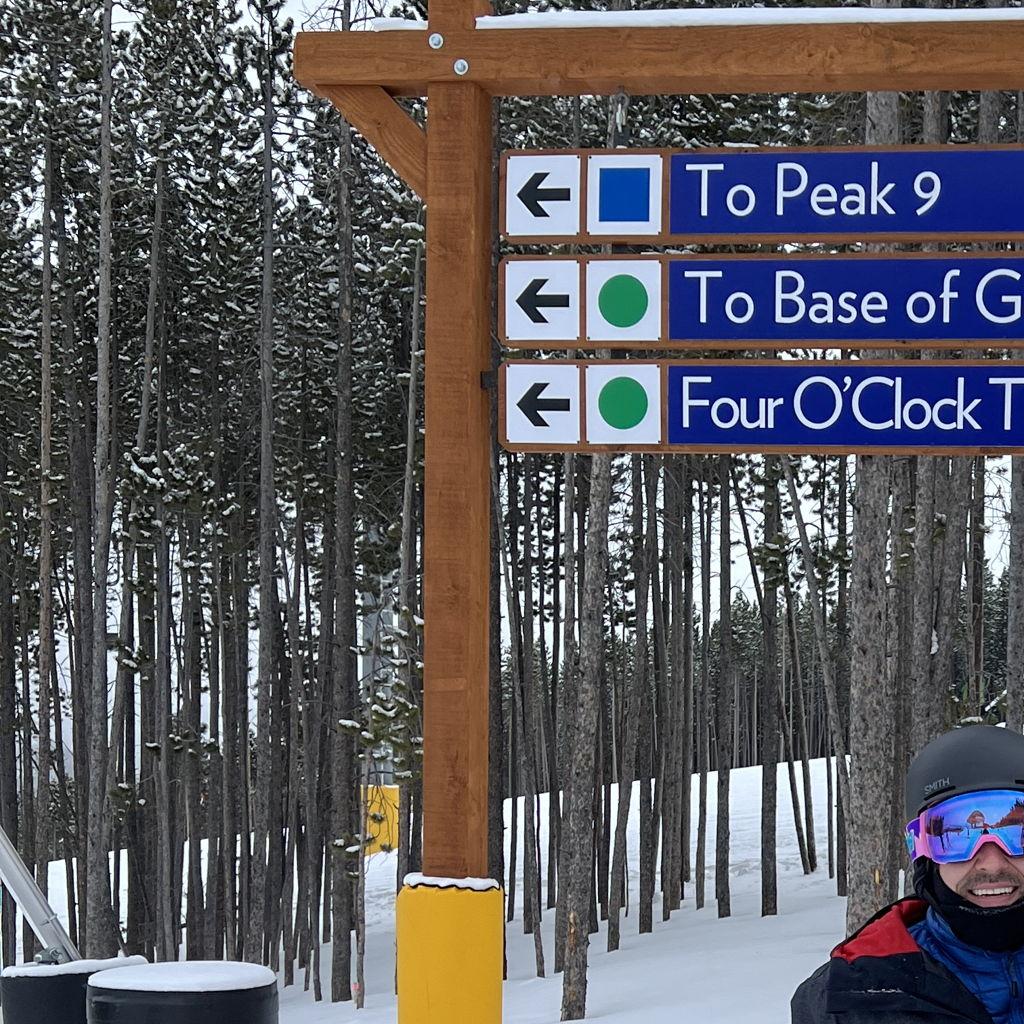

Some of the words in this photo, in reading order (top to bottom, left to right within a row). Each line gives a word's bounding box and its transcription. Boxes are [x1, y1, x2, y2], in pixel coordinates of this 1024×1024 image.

[685, 163, 756, 217] To
[776, 161, 896, 217] Peak
[913, 171, 941, 217] 9
[684, 270, 755, 324] To
[775, 270, 888, 324] Base
[906, 269, 961, 324] of
[682, 376, 784, 430] Four
[793, 375, 982, 431] O'Clock
[924, 777, 950, 795] SMITH
